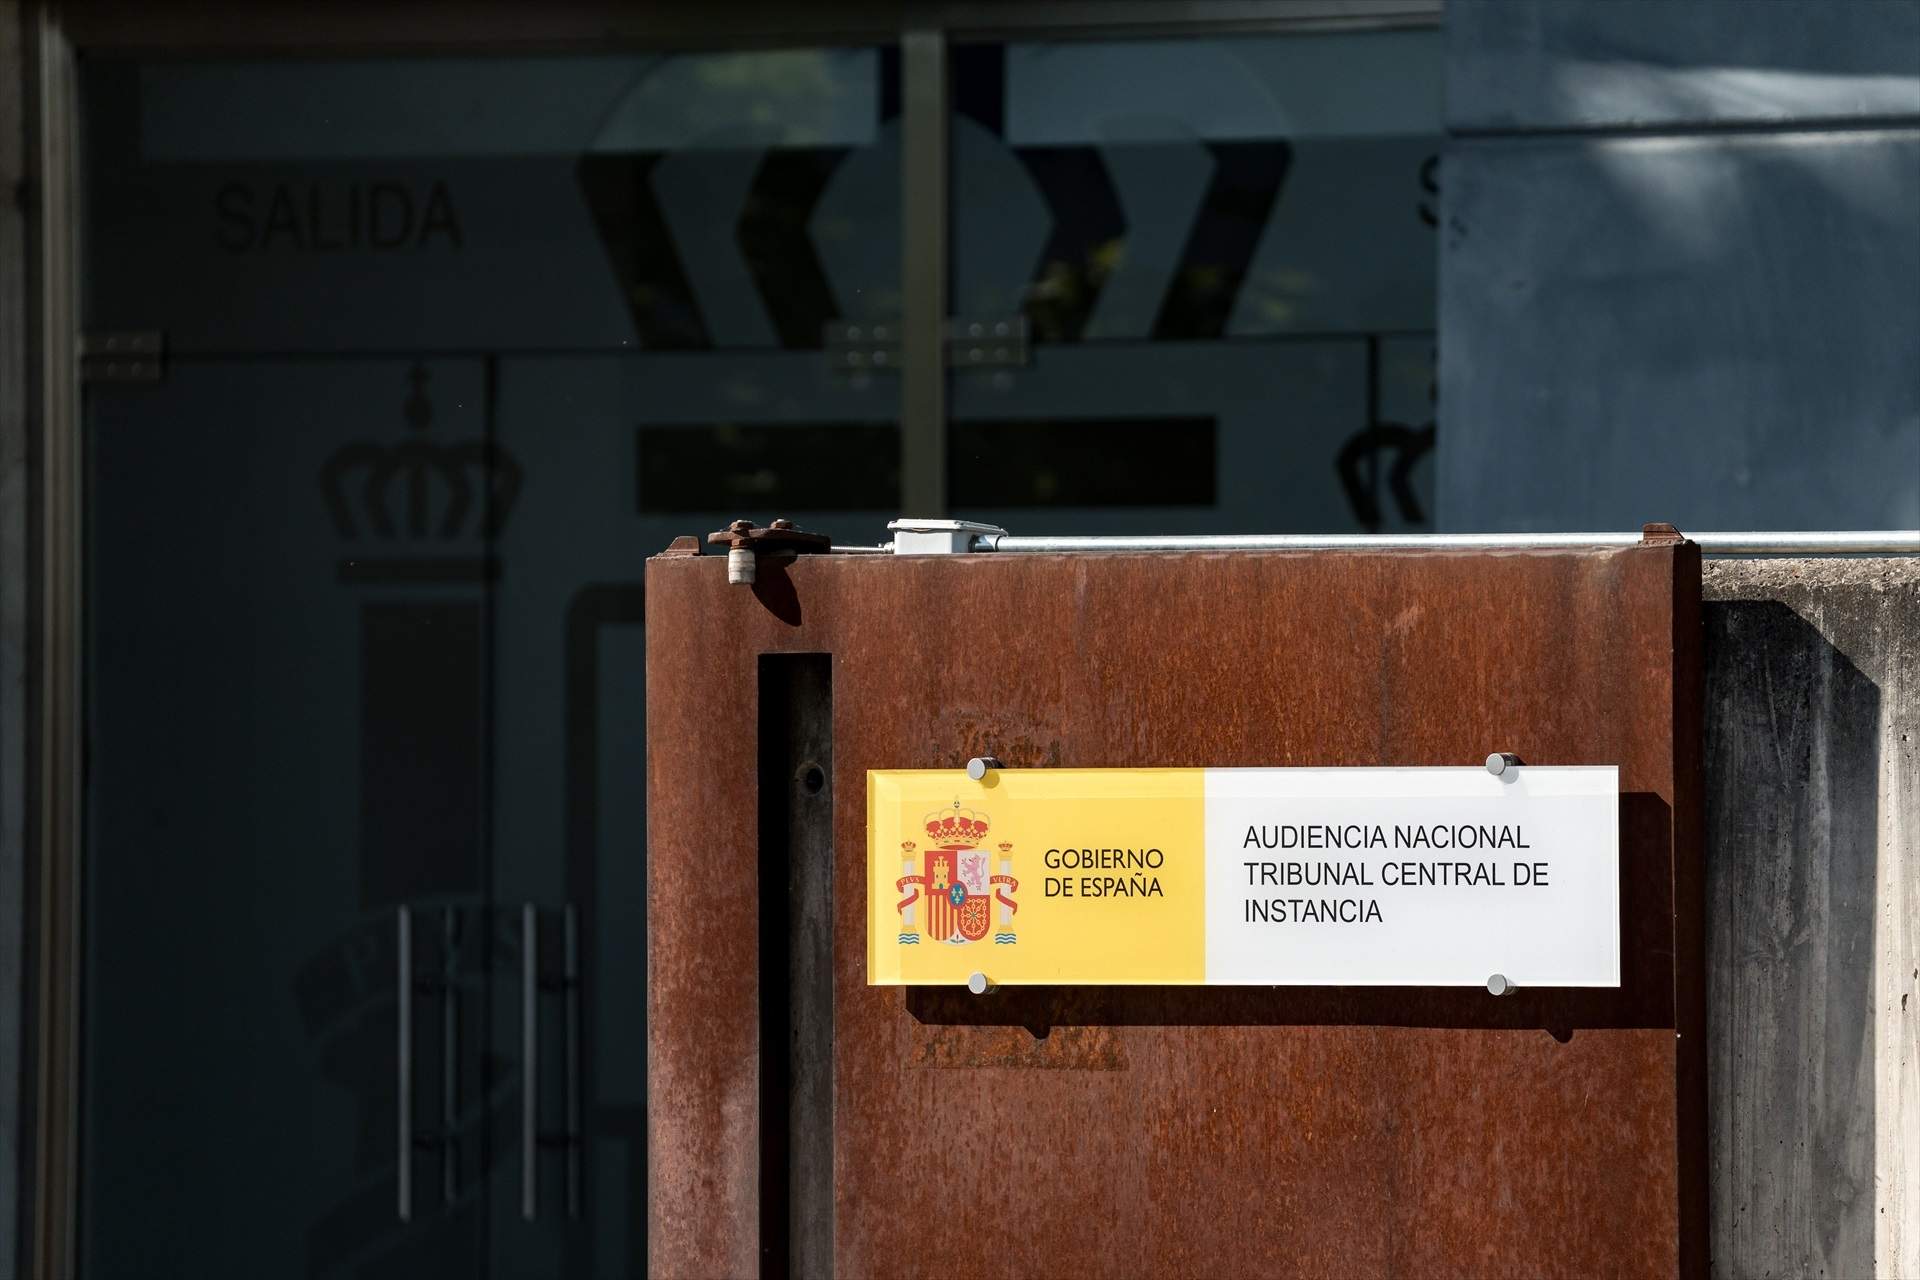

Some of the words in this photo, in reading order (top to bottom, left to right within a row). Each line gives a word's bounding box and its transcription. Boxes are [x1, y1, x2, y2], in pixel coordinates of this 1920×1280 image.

[213, 180, 465, 252] SALIDA
[1243, 824, 1388, 849] AUDIENCIA
[1394, 824, 1531, 849] NACIONAL
[1044, 848, 1164, 870] GOBIERNO
[1044, 877, 1074, 897] DE
[1080, 872, 1164, 898] ESPAÑA
[1243, 861, 1374, 886] TRIBUNAL
[1381, 861, 1506, 886] CENTRAL
[1513, 861, 1549, 886] DE
[1244, 898, 1384, 923] INSTANCIA
